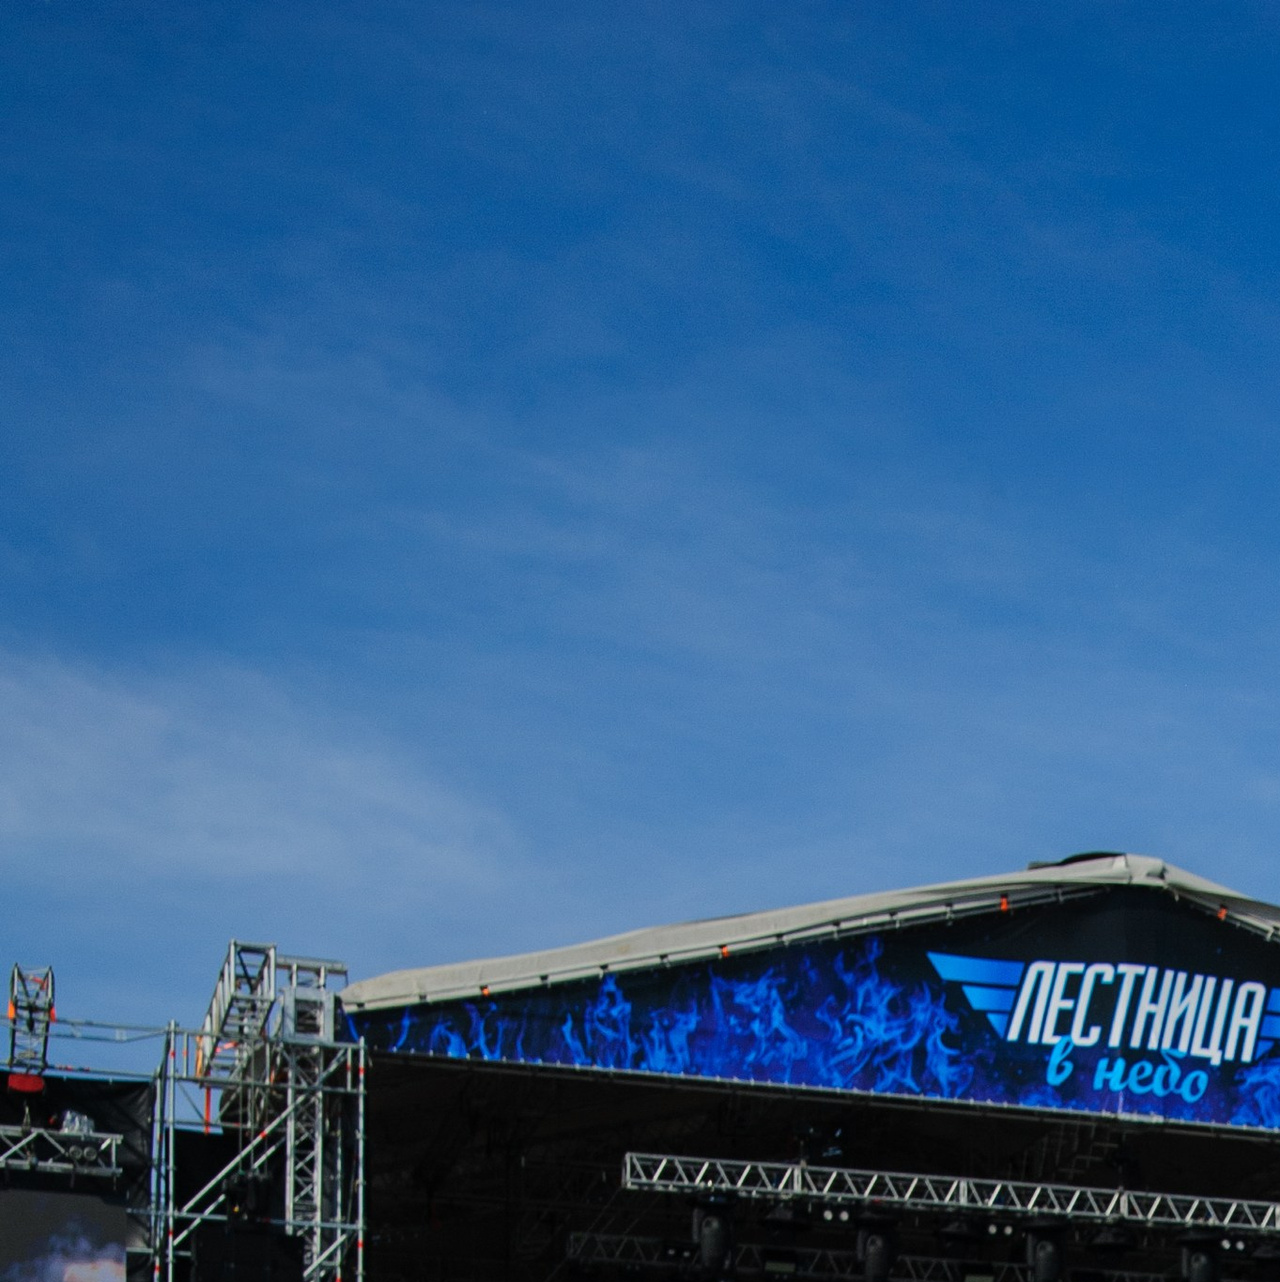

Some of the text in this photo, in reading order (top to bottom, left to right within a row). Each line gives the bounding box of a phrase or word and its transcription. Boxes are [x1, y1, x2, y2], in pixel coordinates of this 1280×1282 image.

[1007, 961, 1266, 1065] ЛЕСТНИЦА
[1046, 1034, 1209, 1103] в небо
